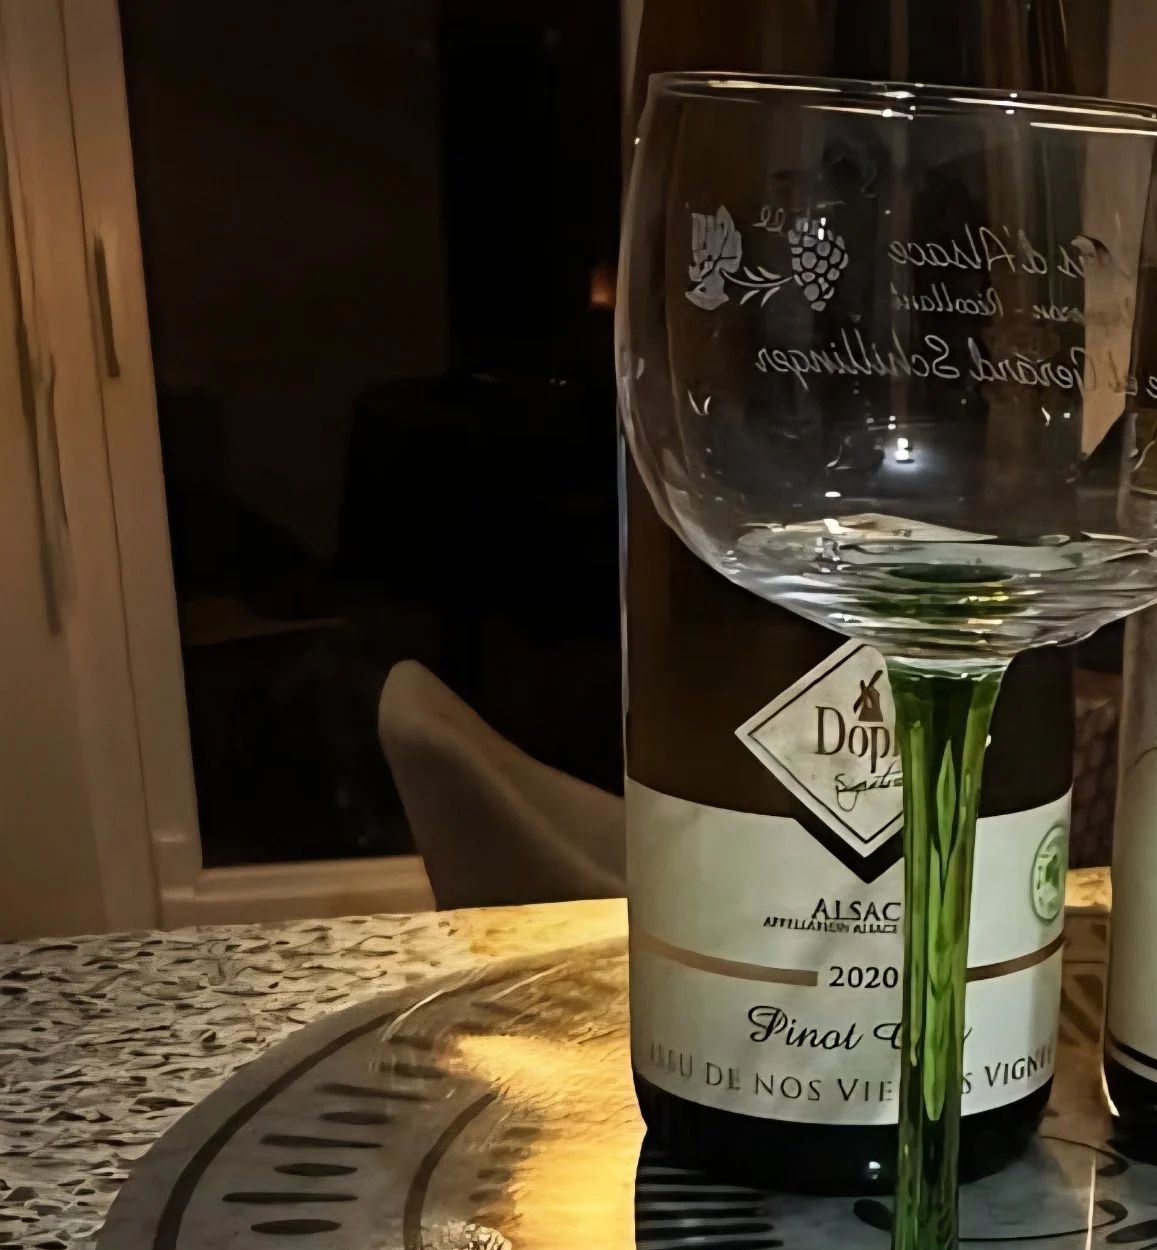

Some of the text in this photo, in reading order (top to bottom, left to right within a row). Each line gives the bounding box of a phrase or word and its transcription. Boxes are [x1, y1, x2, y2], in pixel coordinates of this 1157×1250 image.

[811, 898, 902, 922] ALSAC
[828, 965, 899, 989] 2020
[748, 1004, 865, 1051] Pinot
[706, 1061, 741, 1091] DE
[755, 1072, 823, 1101] NOS
[984, 1040, 1054, 1087] VIGN
